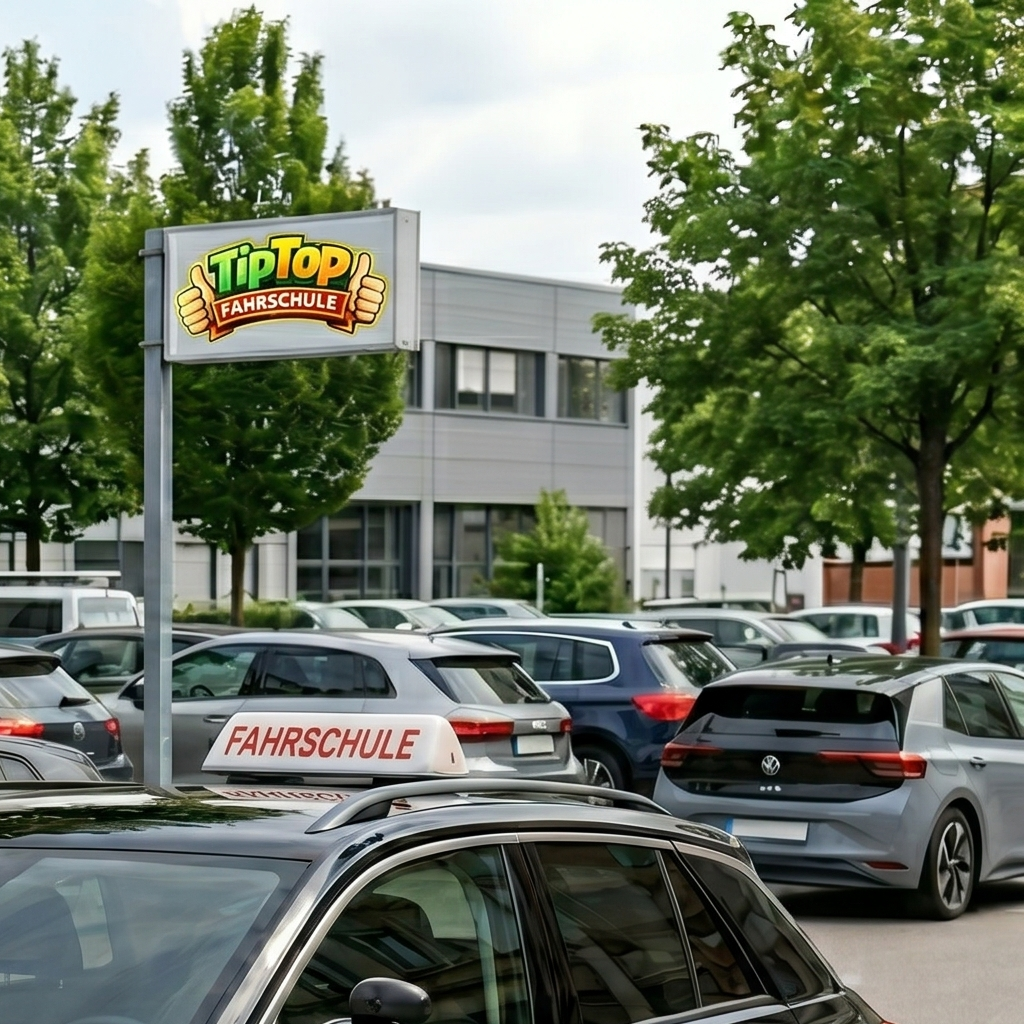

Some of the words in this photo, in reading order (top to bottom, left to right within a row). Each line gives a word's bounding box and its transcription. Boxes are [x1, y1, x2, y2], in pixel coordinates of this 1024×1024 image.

[209, 235, 351, 294] TipTop
[220, 291, 338, 318] FAHRSCHULE
[224, 725, 421, 760] FAHRSCHULE
